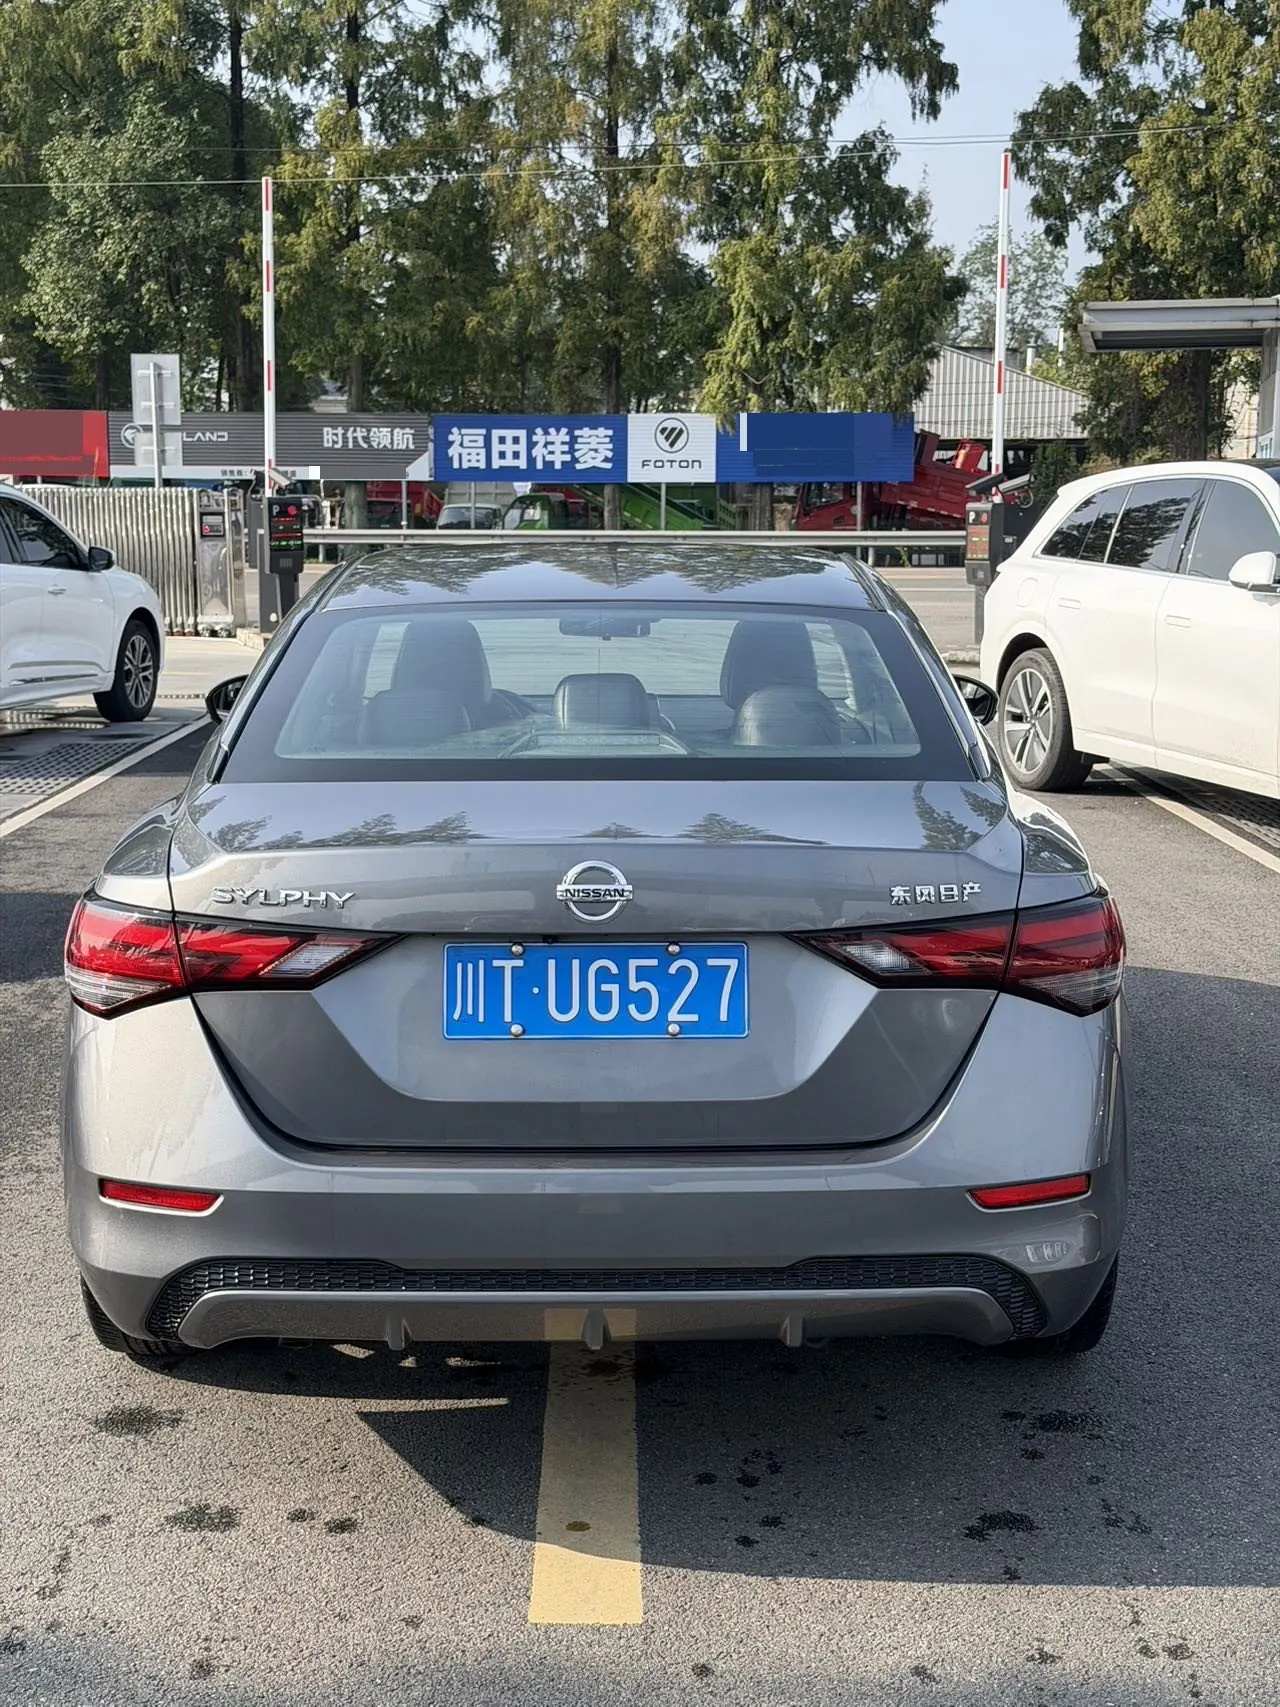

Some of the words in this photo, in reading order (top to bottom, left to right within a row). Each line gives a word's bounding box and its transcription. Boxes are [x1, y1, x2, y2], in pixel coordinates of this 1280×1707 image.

[322, 426, 415, 449] 时代领航
[447, 426, 613, 470] 福田祥菱
[641, 459, 702, 469] FOTON
[272, 505, 280, 516] P
[969, 511, 976, 523] P
[211, 887, 356, 909] SYLPHY
[564, 888, 625, 898] NISSAN
[890, 882, 982, 905] 东风日产
